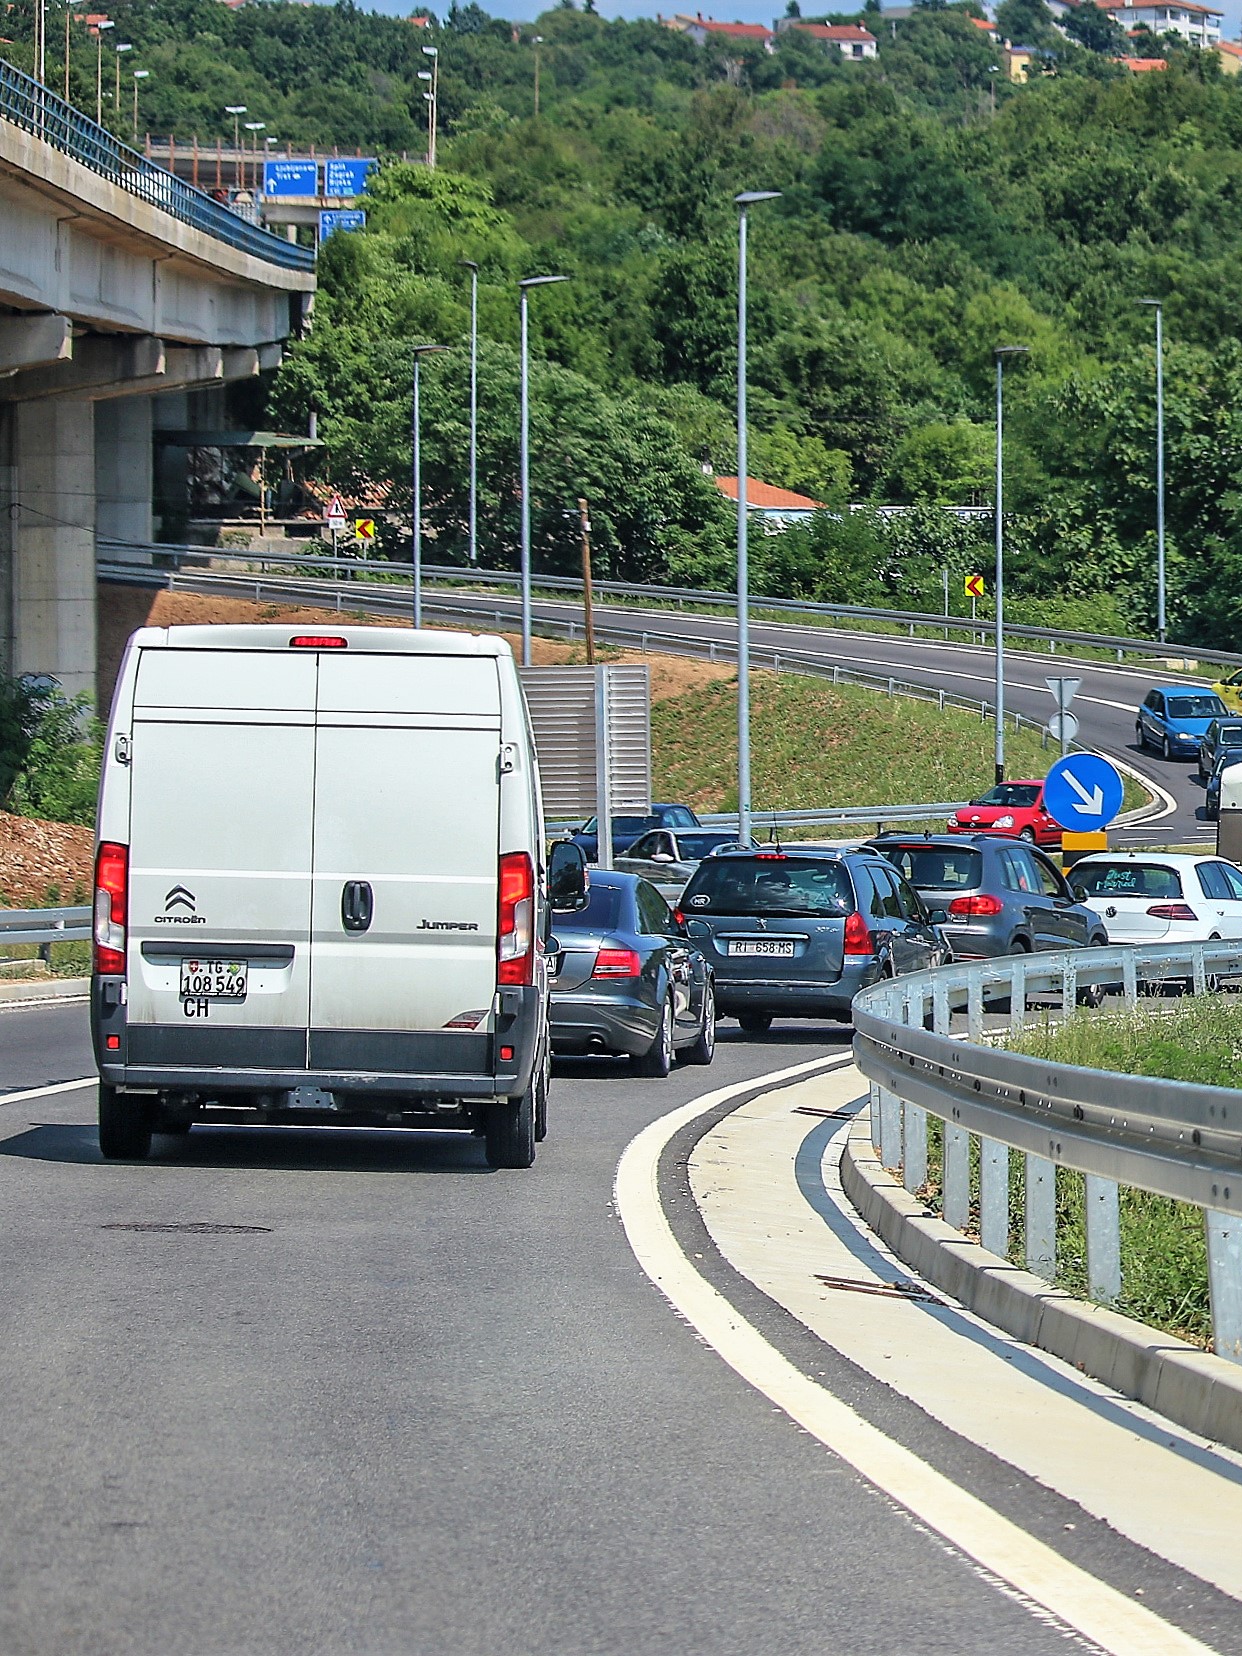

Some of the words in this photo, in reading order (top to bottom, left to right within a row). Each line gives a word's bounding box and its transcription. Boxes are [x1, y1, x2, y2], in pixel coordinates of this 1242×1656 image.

[694, 897, 706, 905] HR
[735, 941, 747, 953] RI
[207, 961, 223, 974] TG
[183, 998, 209, 1018] CH
